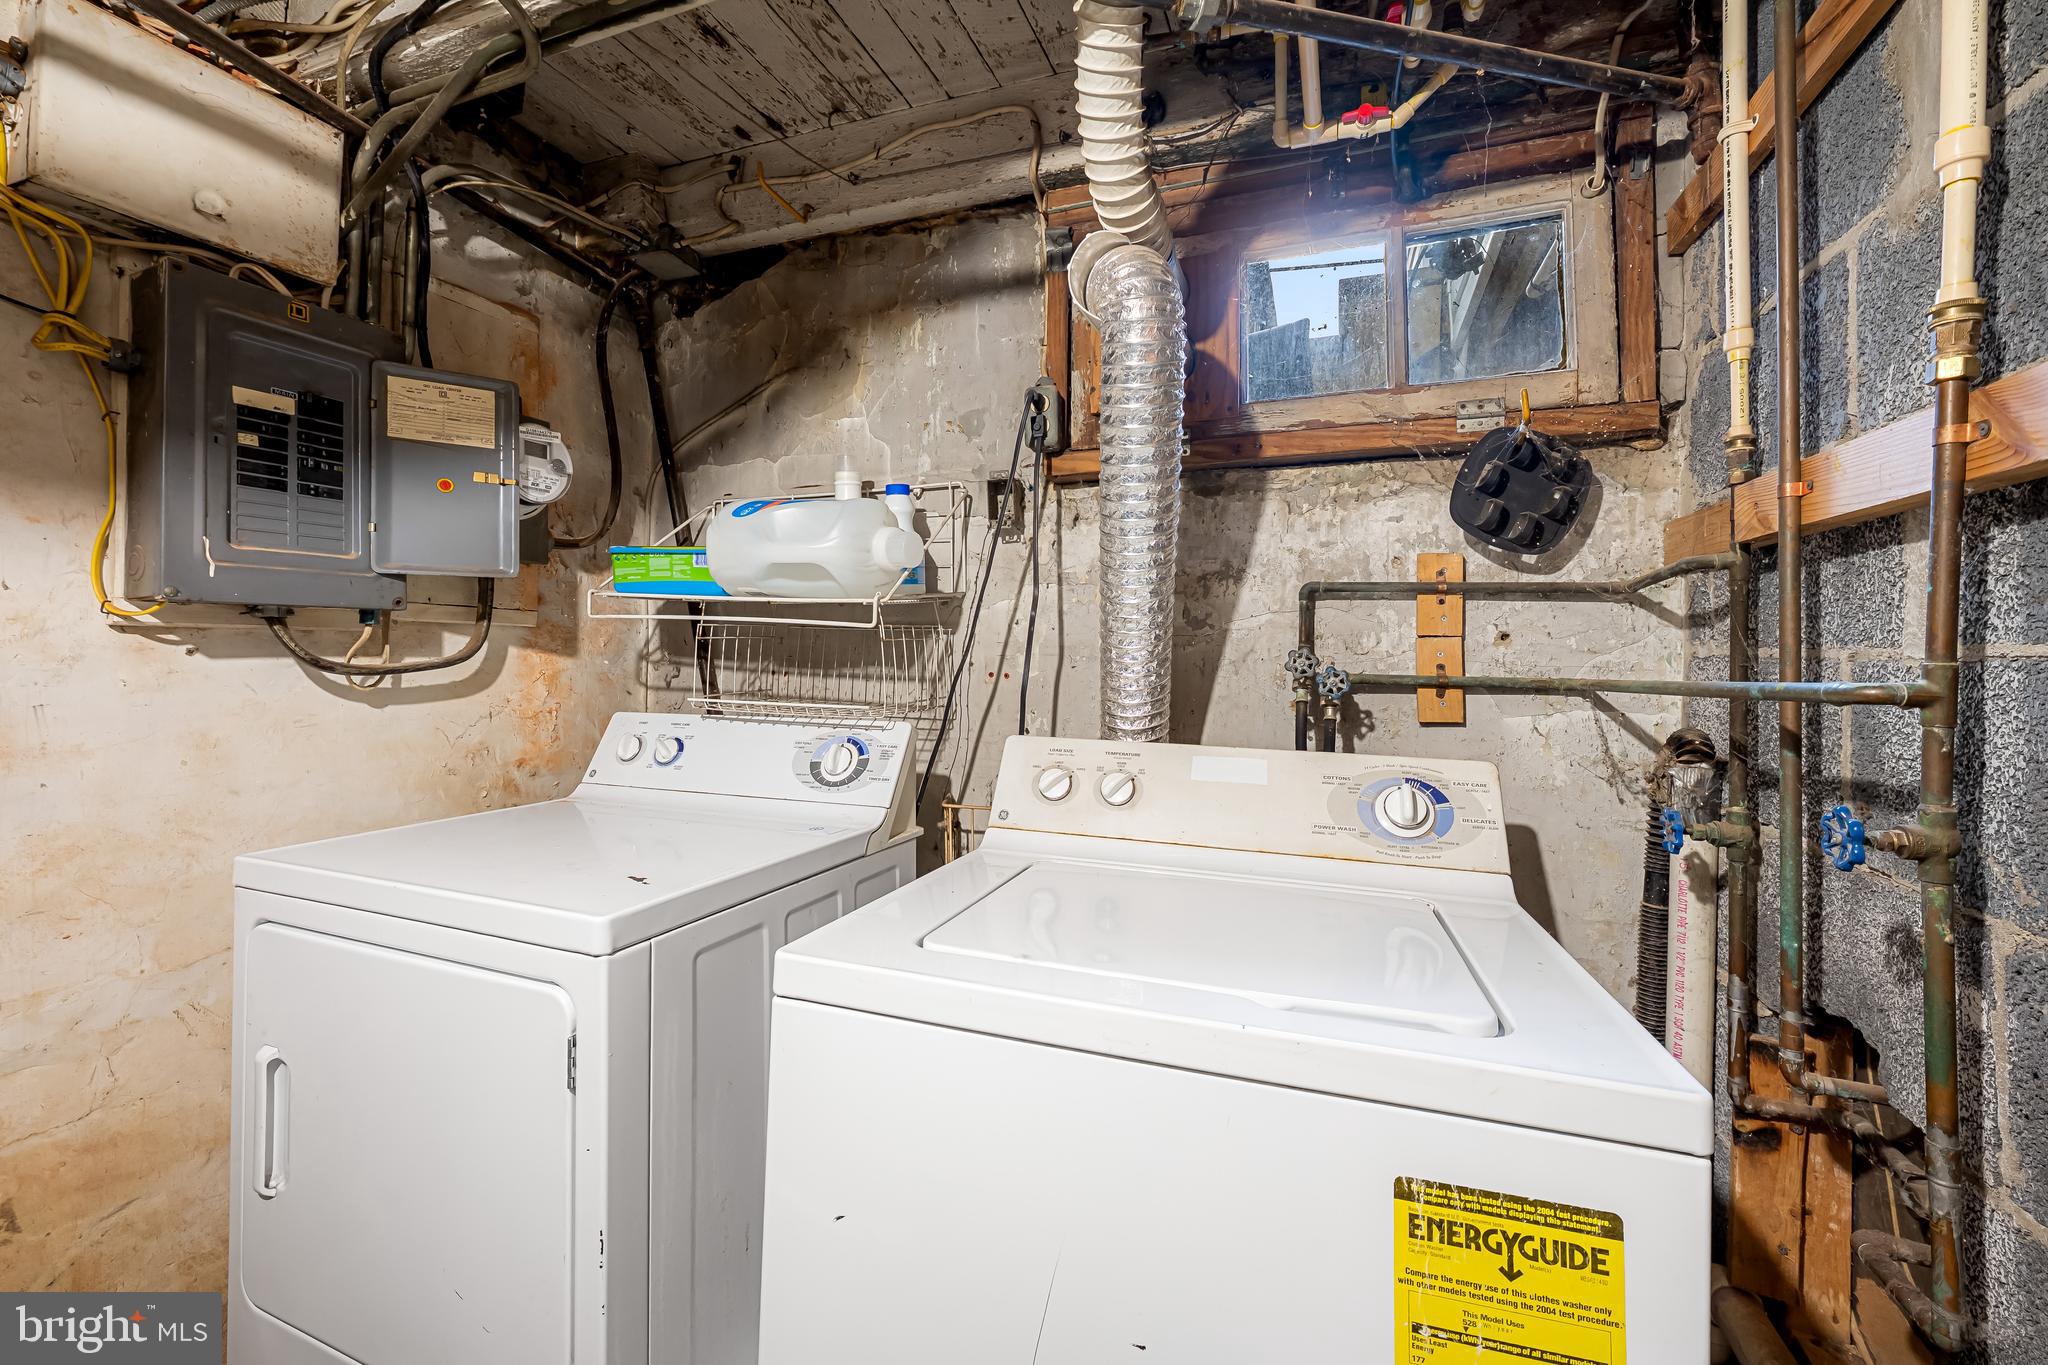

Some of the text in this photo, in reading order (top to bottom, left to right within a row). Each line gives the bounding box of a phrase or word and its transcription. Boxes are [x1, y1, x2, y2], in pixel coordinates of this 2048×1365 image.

[274, 389, 296, 399] MAIN
[1676, 880, 1689, 914] CHARLOTTE
[1676, 916, 1689, 930] PIPE
[1675, 966, 1686, 978] PVC
[1674, 995, 1685, 1010] TYPE
[1673, 1031, 1684, 1041] 40
[1425, 1186, 1447, 1197] model
[1461, 1192, 1478, 1203] been
[1479, 1196, 1502, 1208] tested
[1503, 1200, 1522, 1211] using
[1523, 1204, 1536, 1213] the
[1537, 1206, 1555, 1217] 2004
[1556, 1209, 1571, 1220] test
[1572, 1213, 1613, 1228] procedure.
[1465, 1201, 1481, 1212] with
[1482, 1204, 1508, 1216] models
[1508, 1209, 1545, 1224] displaying
[1546, 1215, 1561, 1226] this
[1562, 1218, 1602, 1233] statement.
[1408, 1212, 1610, 1278] ENERGYGUIDE
[1405, 1266, 1439, 1281] Compare
[1440, 1271, 1454, 1284] the
[1455, 1278, 1483, 1292] energy
[1501, 1286, 1510, 1295] of
[1511, 1288, 1528, 1299] this
[1529, 1292, 1561, 1306] clothes
[1562, 1300, 1593, 1312] washer
[1594, 1306, 1613, 1318] only
[1397, 1276, 1624, 1329] with other models tested using the 2004 test procedure.
[1462, 1309, 1525, 1330] This Model Uses
[1462, 1318, 1478, 1328] 528
[1429, 1338, 1448, 1349] Least
[1411, 1354, 1426, 1364] 177
[1500, 1343, 1522, 1355] range
[1522, 1347, 1531, 1356] of
[1531, 1349, 1542, 1358] all
[1542, 1351, 1569, 1363] similar
